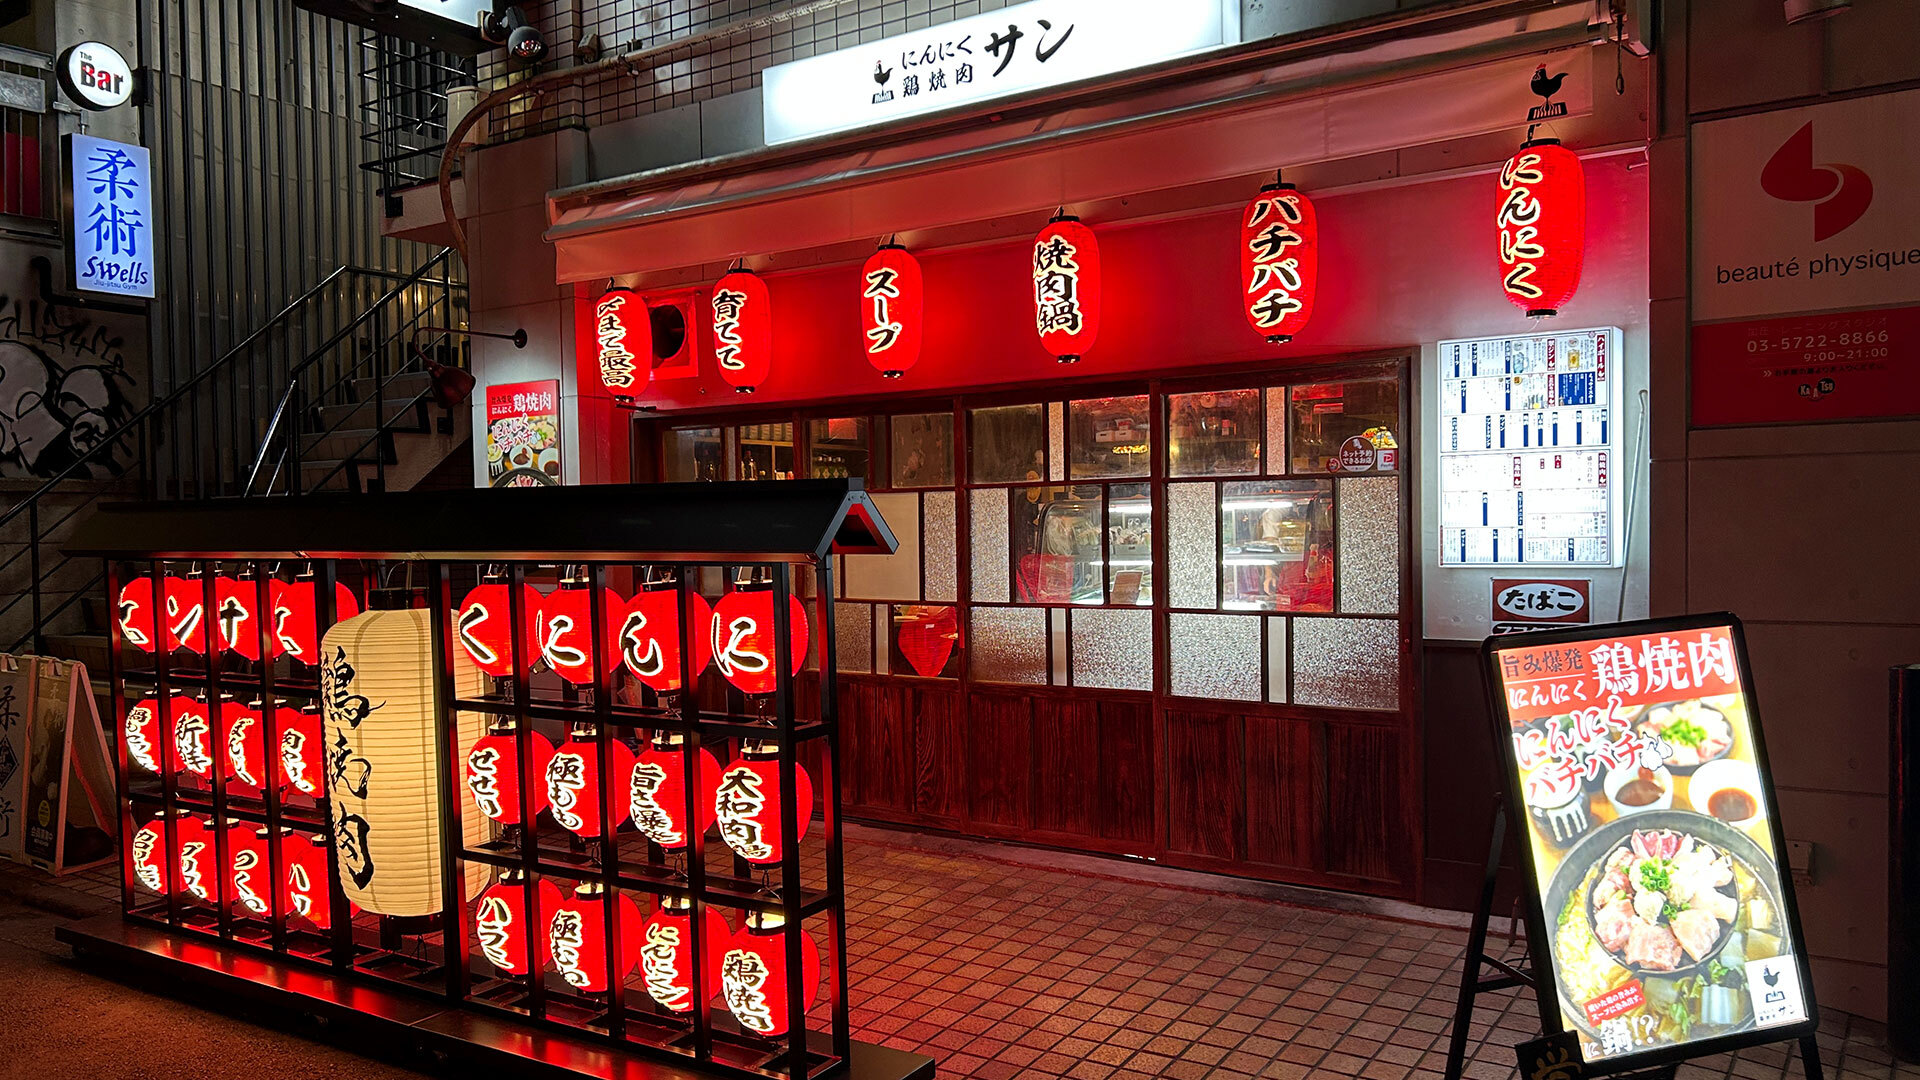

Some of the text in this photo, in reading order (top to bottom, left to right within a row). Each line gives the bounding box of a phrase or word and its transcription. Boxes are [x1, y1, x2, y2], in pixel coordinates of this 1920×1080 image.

[80, 51, 92, 61] The
[80, 60, 124, 95] Bar
[901, 34, 973, 69] にんにく
[902, 62, 973, 98] 鶏焼肉
[984, 19, 1074, 77] サン
[84, 147, 143, 257] 柔術
[1498, 153, 1544, 298] にんにく
[82, 256, 148, 285] Swells
[122, 282, 138, 290] Gym
[1033, 234, 1083, 337] 焼肉鍋
[1248, 195, 1302, 328] バチバチ
[1716, 248, 1920, 284] beauté physique
[597, 296, 635, 387] 〆まで最高
[712, 289, 747, 370] 育てて
[864, 267, 902, 353] スープ
[1747, 330, 1889, 353] 03-5722-8866
[491, 413, 529, 440] にんにく
[513, 391, 552, 412] 鶏焼肉
[1503, 588, 1576, 611] たばこ
[1503, 648, 1584, 678] 旨み爆発
[1508, 679, 1587, 709] にんにく
[1588, 633, 1736, 699] 鶏焼肉
[1512, 695, 1631, 769] にんにく
[1527, 730, 1645, 800] バチバチ
[469, 747, 503, 817] せせり
[546, 753, 585, 830] 極もも
[631, 762, 682, 844] 旨さ爆発
[716, 766, 772, 859] 大和肉鶏
[234, 849, 268, 913] つくね
[477, 897, 514, 969] ハラミ
[550, 909, 590, 986] 極むね
[722, 949, 774, 1032] 鶏焼肉
